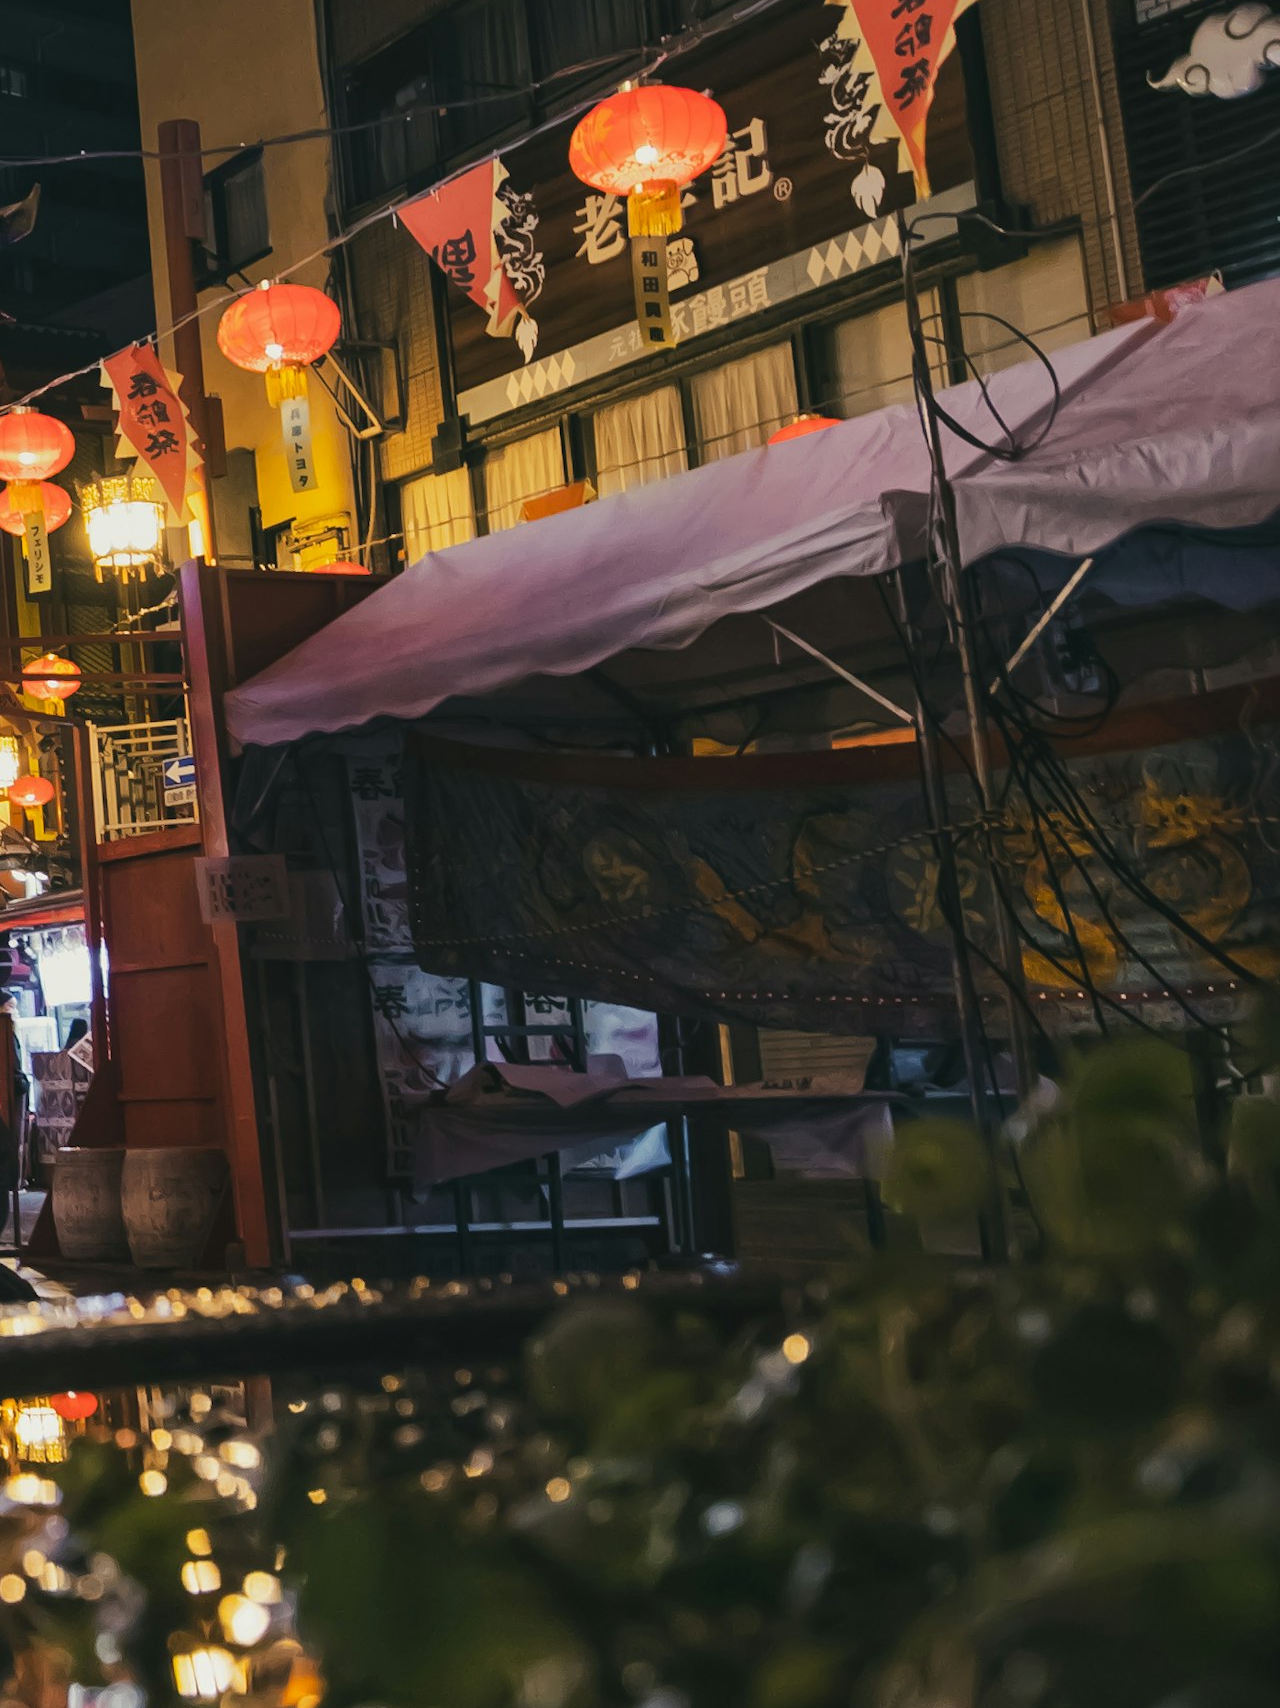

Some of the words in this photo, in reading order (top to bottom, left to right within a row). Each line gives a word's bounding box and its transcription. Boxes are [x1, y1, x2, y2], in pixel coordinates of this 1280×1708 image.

[572, 117, 773, 265] 老記
[30, 525, 44, 584] フェリシモ
